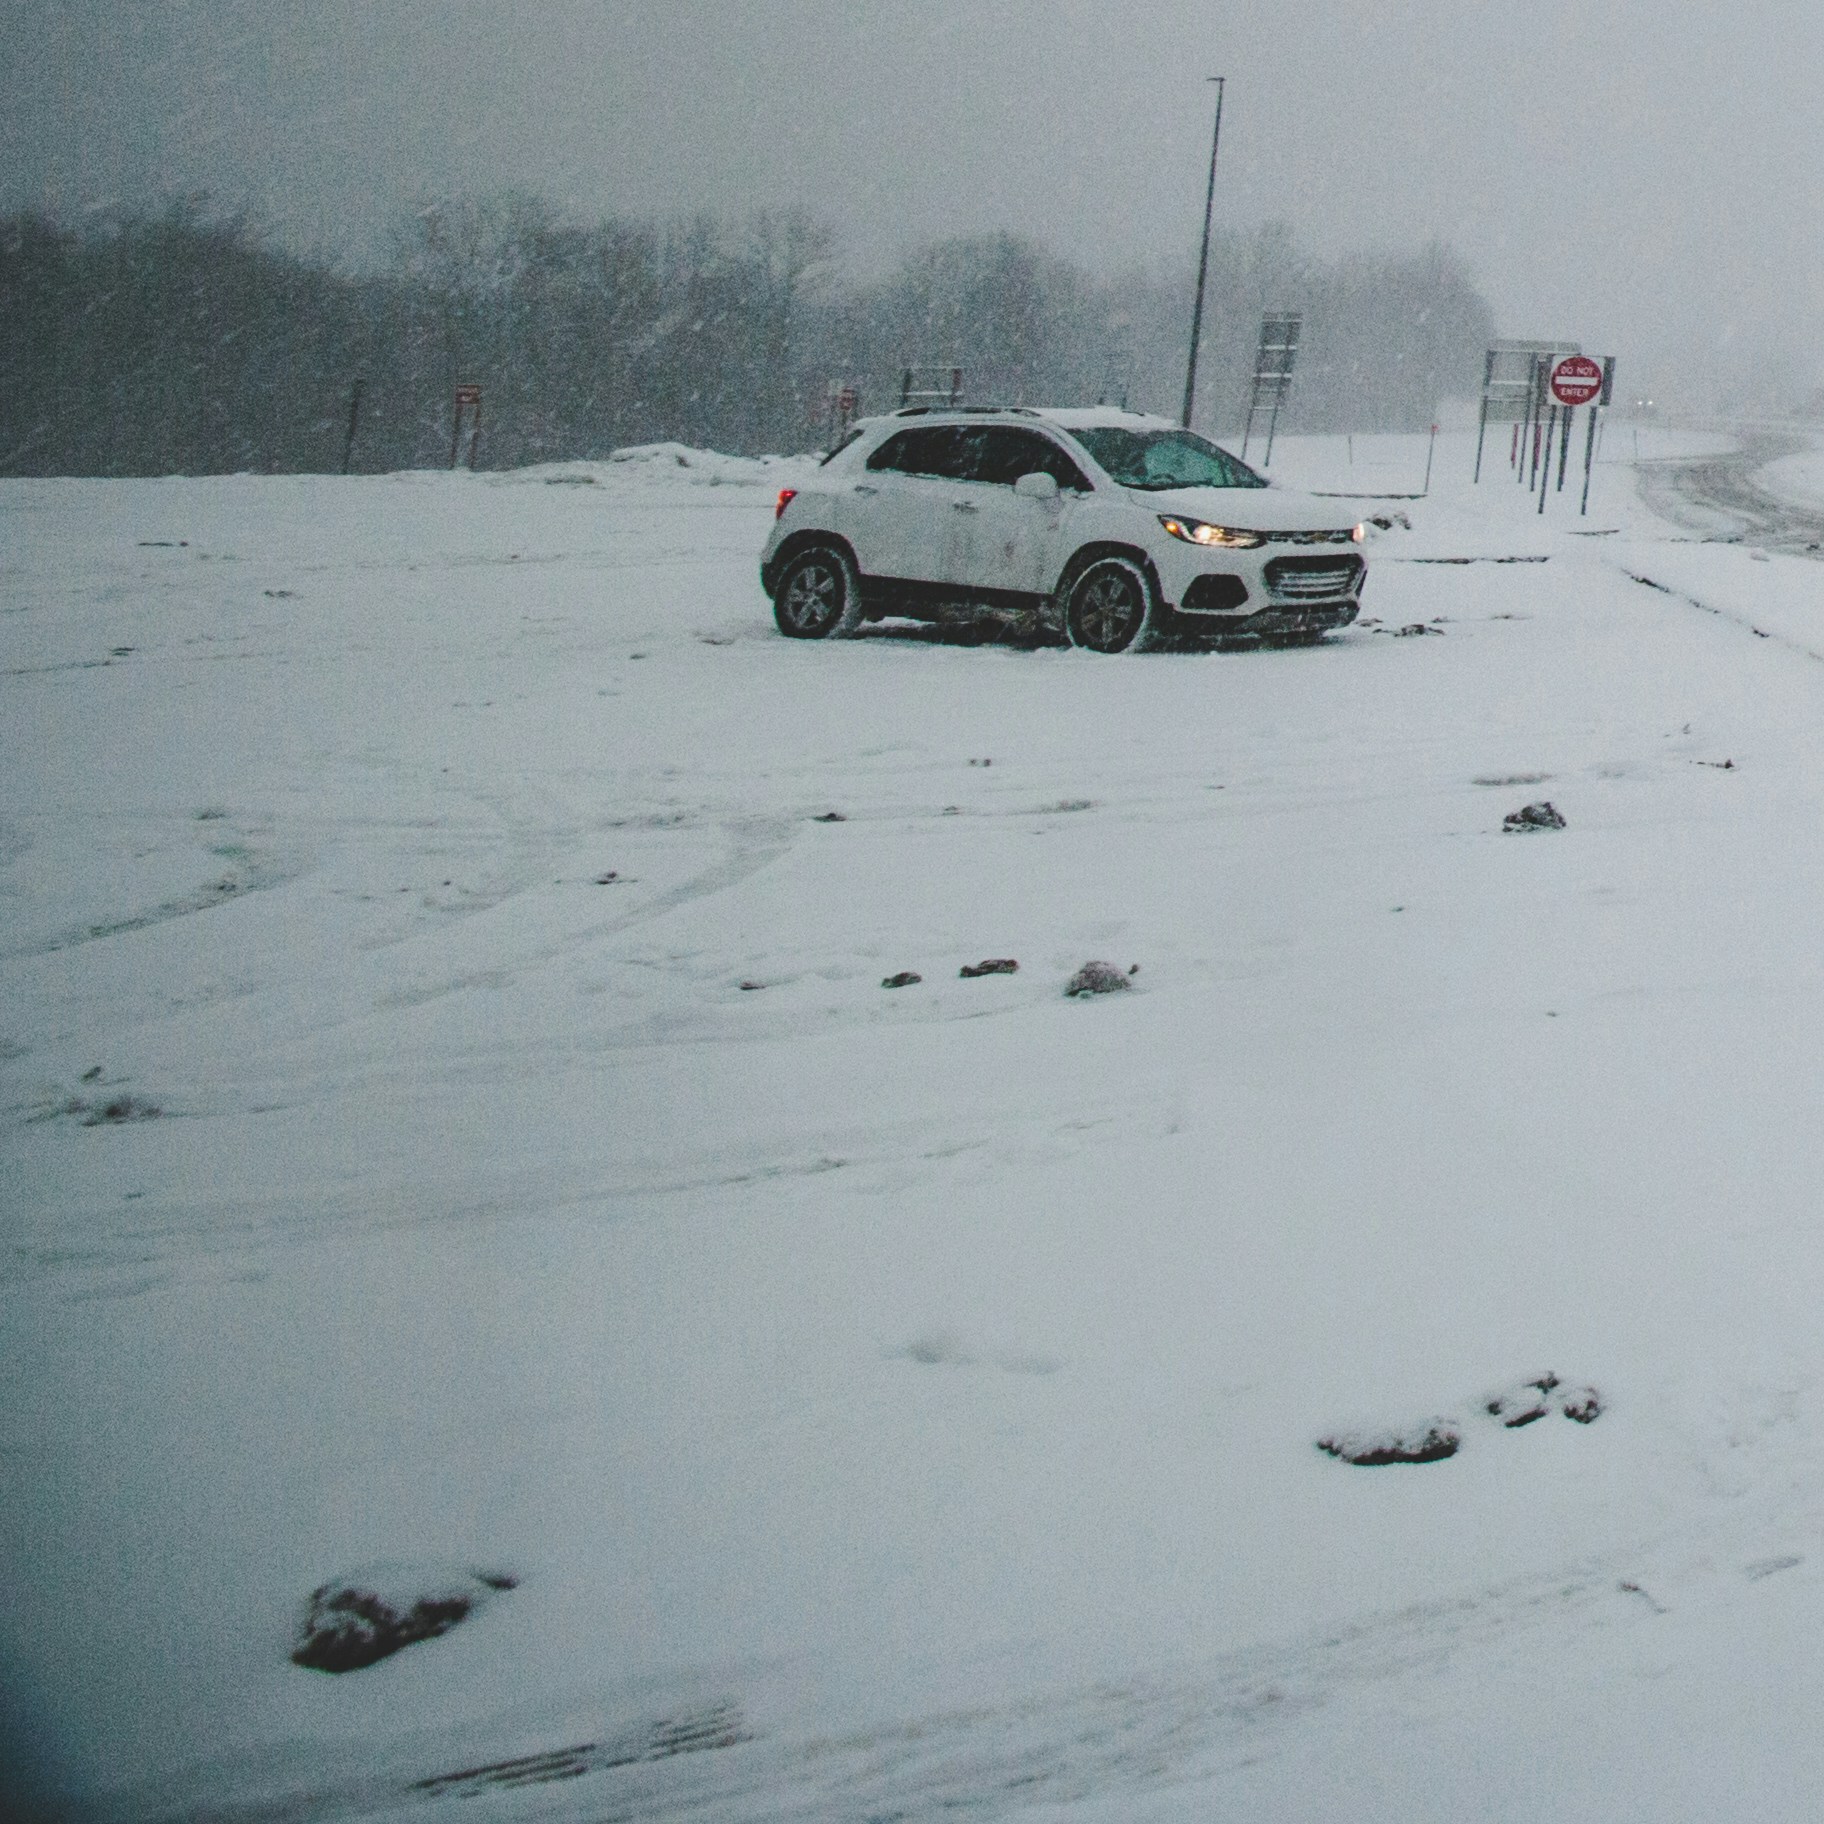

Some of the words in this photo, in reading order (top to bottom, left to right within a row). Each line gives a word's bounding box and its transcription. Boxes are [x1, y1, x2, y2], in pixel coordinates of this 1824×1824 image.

[1561, 366, 1573, 375] DO
[1577, 366, 1593, 375] NOT
[1561, 387, 1588, 396] ENTER
